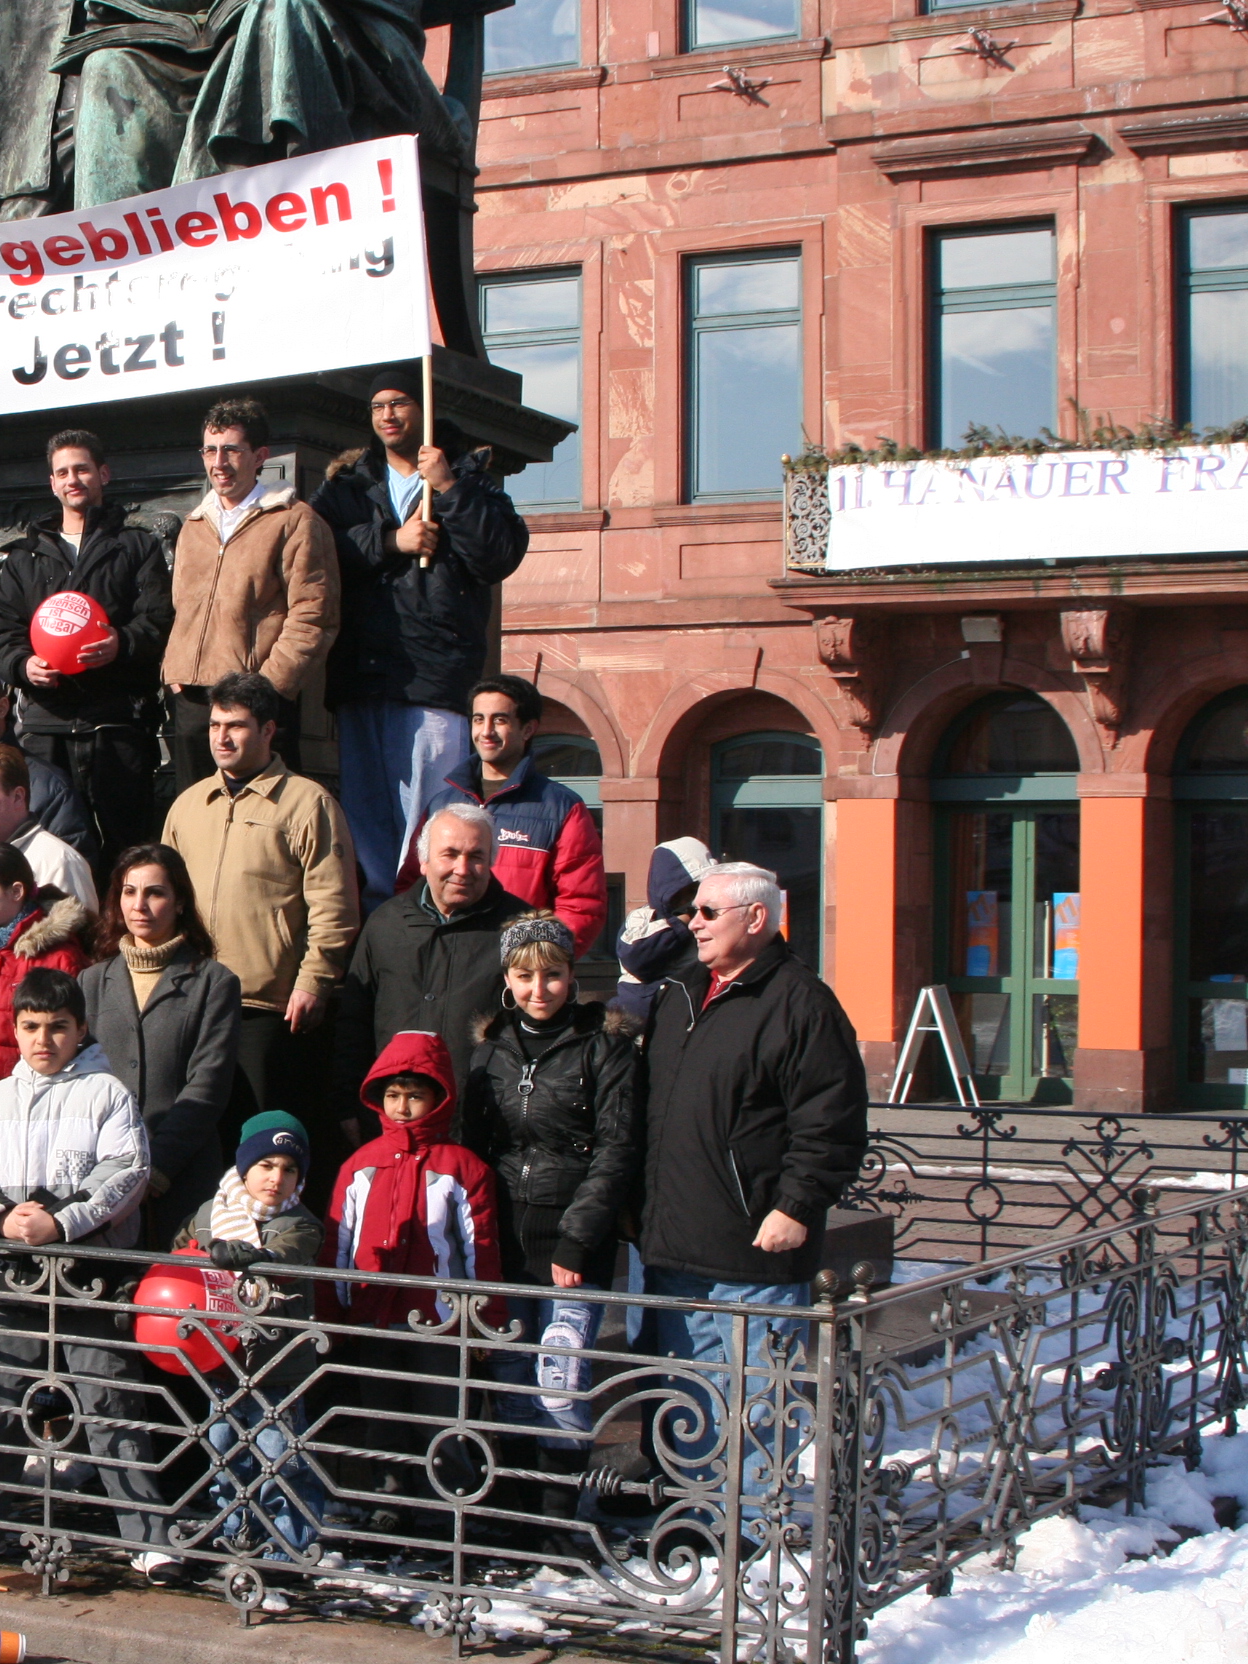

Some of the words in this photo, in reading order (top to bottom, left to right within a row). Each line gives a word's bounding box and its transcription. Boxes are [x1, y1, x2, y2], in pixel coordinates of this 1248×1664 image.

[0, 182, 352, 286] geblieben
[12, 321, 185, 385] Jetzt
[45, 598, 88, 616] mensch
[64, 594, 86, 607] kein
[49, 609, 63, 617] ist
[40, 618, 75, 634] illegal
[55, 1149, 96, 1160] EXTREM
